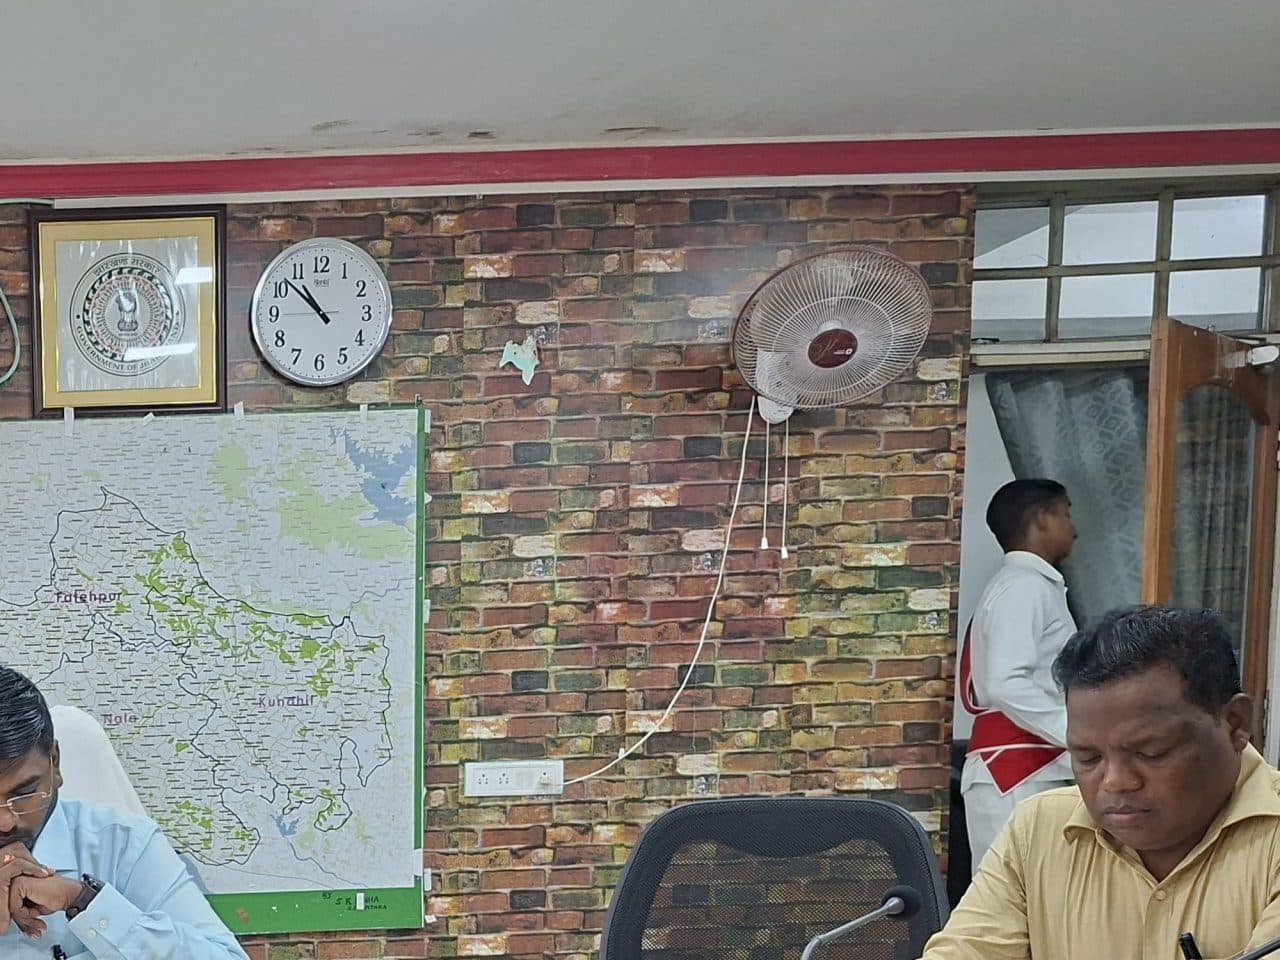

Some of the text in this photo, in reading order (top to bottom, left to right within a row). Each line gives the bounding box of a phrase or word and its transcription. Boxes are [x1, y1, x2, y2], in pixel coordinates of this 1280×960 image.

[131, 259, 160, 273] सरकार
[292, 262, 304, 280] 11
[313, 255, 330, 273] 12
[342, 262, 348, 279] 1
[273, 280, 288, 298] 10
[356, 280, 366, 297] 2
[269, 305, 279, 323] 9
[361, 304, 372, 321] 3
[274, 330, 285, 347] 8
[355, 328, 365, 346] 4
[76, 326, 124, 370] GOVERNMENT
[127, 363, 136, 371] OF
[291, 348, 302, 365] 7
[337, 347, 348, 365] 5
[314, 353, 325, 371] 6
[56, 591, 122, 604] Fatehpur
